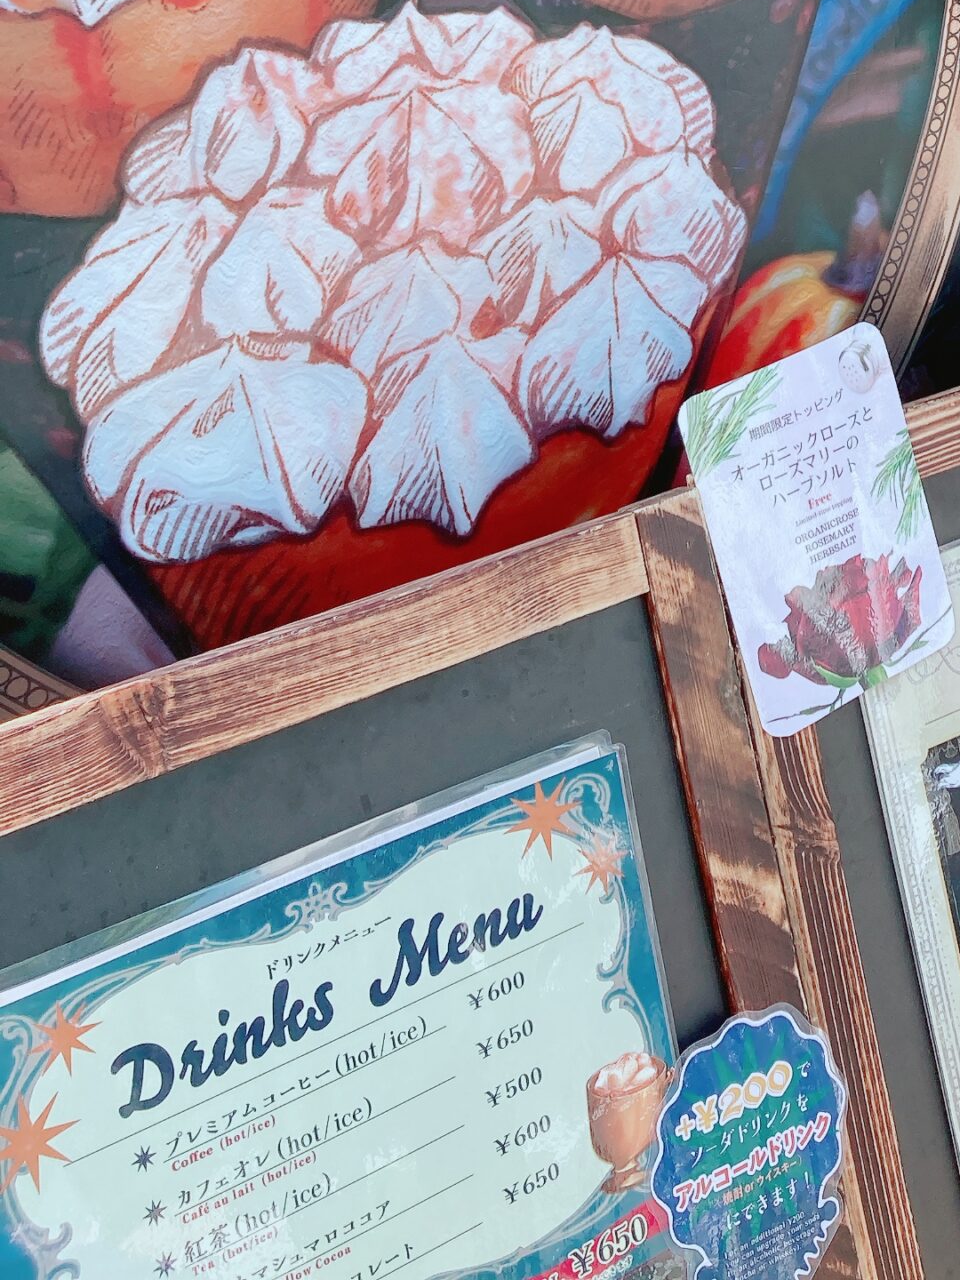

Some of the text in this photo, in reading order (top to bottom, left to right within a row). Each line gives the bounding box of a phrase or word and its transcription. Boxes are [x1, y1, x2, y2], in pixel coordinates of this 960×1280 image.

[749, 388, 844, 442] 期間限定トッピング
[731, 406, 873, 481] オーガニックローズと
[759, 435, 860, 492] ローズマリーの
[808, 492, 832, 510] Free
[805, 523, 855, 554] ROSEMARY
[809, 535, 857, 565] HERBSALT
[266, 915, 392, 980] ドリンクメニュー
[110, 892, 545, 1119] Drinks Menu
[466, 971, 525, 1010] ¥600
[475, 1019, 534, 1060] ¥650
[484, 1066, 542, 1108] ¥500
[171, 1114, 277, 1172] Coffee (hot/ice)
[493, 1114, 551, 1157] ¥600
[181, 1151, 317, 1225] Café au lait (hot/ice)
[502, 1162, 560, 1205] ¥650
[673, 1112, 831, 1213] アルコールドリンク
[191, 1225, 280, 1278] Tea (hot/ice)
[315, 1245, 352, 1270] Cocoa
[568, 1214, 647, 1279] ¥650
